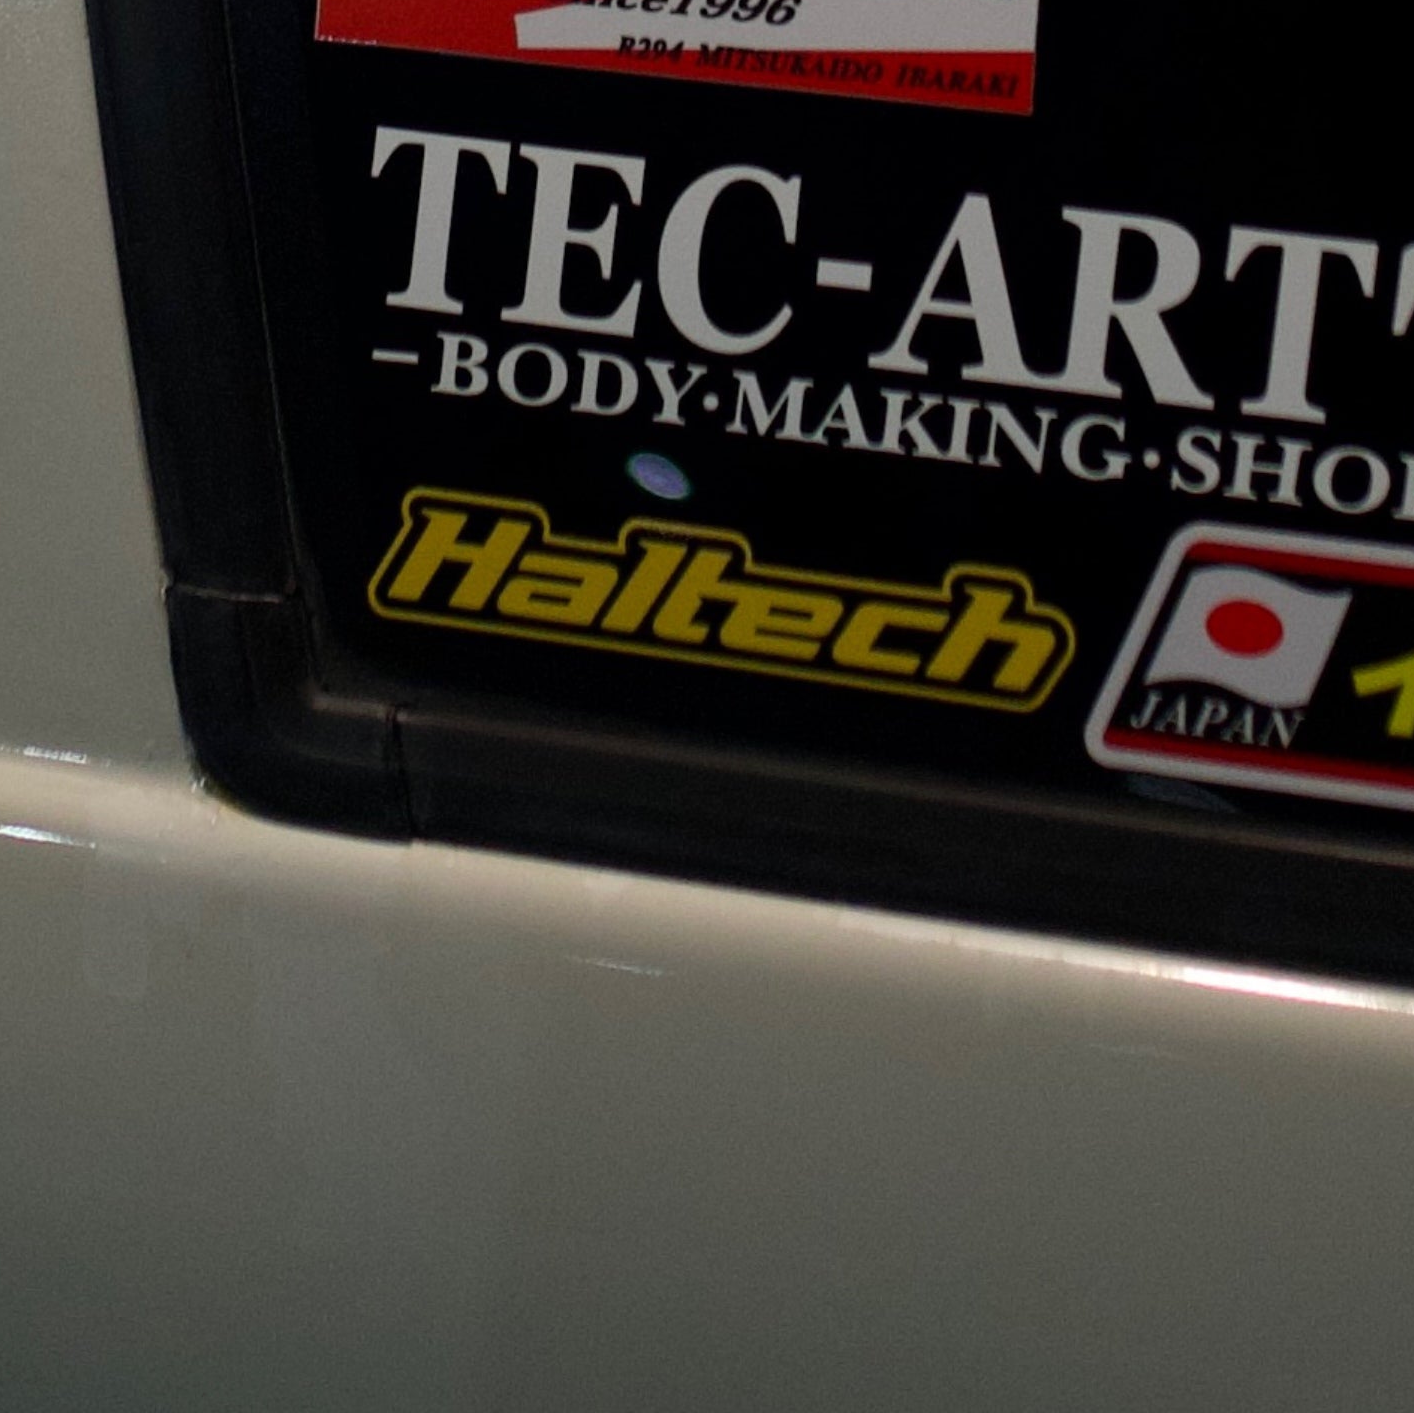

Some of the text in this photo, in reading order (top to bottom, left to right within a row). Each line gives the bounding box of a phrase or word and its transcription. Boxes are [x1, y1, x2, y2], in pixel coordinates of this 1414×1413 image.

[617, 34, 1019, 100] R294 MITSUKAIDO IBARAKI
[388, 508, 1057, 692] Haltech
[1129, 687, 1308, 750] JAPAN
